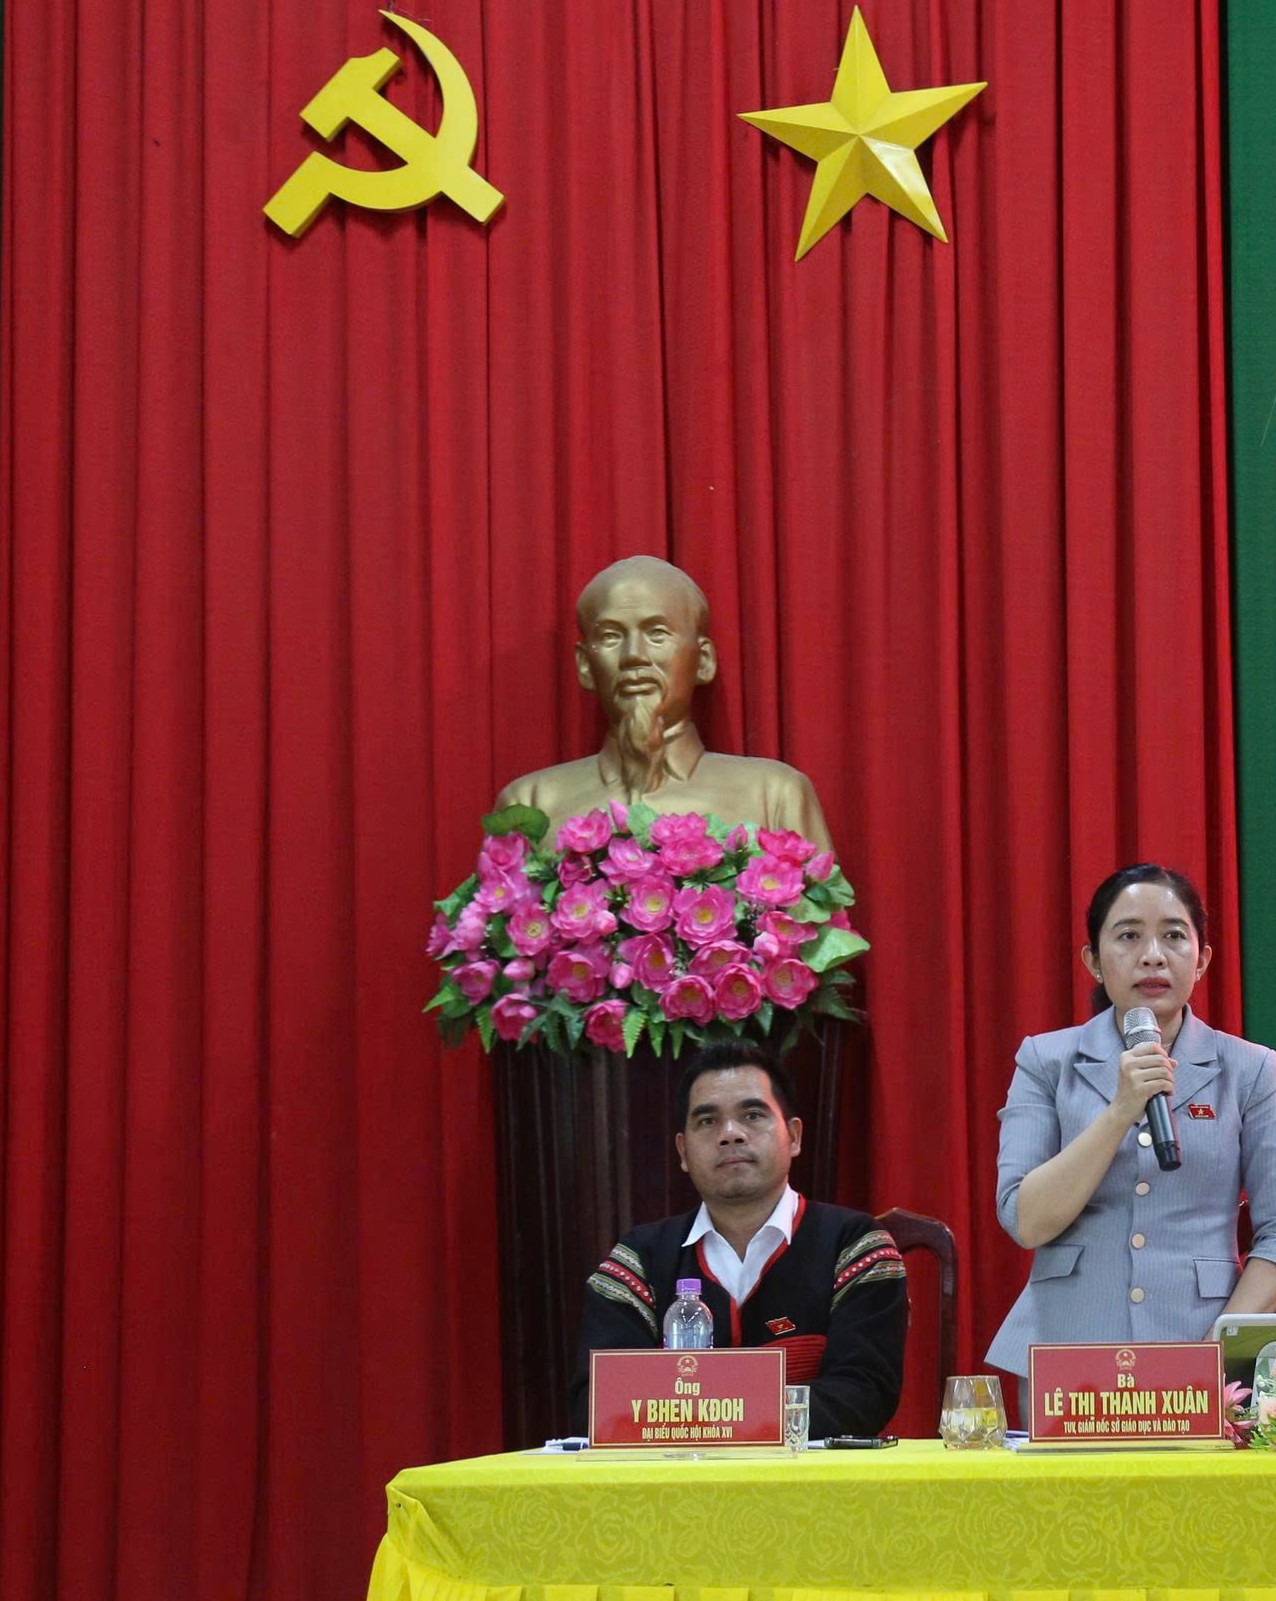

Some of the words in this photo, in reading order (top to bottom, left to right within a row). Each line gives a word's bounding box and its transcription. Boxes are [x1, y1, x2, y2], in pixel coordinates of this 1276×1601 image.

[674, 1377, 700, 1396] Ông
[1117, 1373, 1135, 1388] Bà
[631, 1399, 642, 1423] Y
[647, 1398, 693, 1423] BHEN
[698, 1398, 744, 1422] KĐOH
[1044, 1387, 1064, 1416] LÊ
[1069, 1391, 1095, 1420] THỊ
[1100, 1391, 1157, 1416] THANH
[1161, 1385, 1209, 1414] XUÂN
[642, 1427, 654, 1442] ĐẠI
[655, 1422, 670, 1439] BIỂU
[671, 1423, 689, 1440] QUỐC
[690, 1424, 702, 1441] HỘI
[721, 1426, 733, 1438] XVI
[1121, 1418, 1137, 1432] GIÁO
[1153, 1418, 1162, 1432] VÀ
[1178, 1419, 1190, 1434] TẠO
